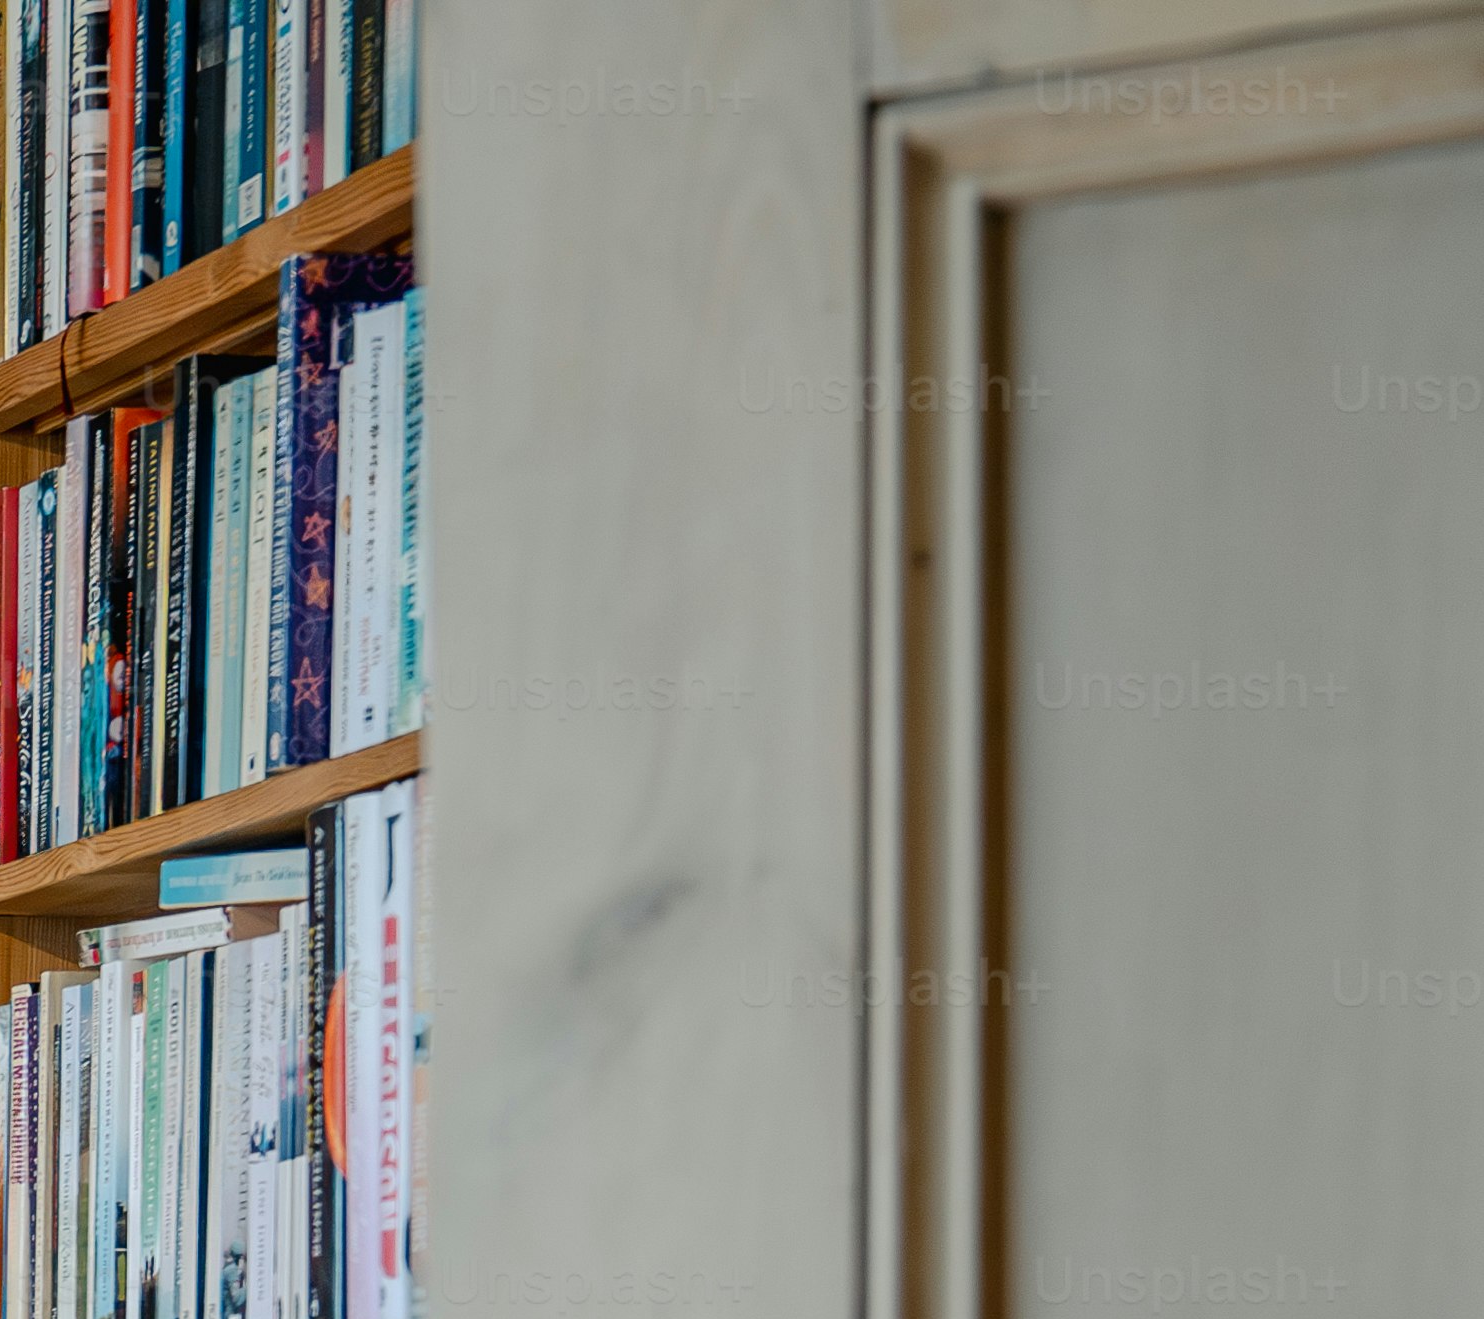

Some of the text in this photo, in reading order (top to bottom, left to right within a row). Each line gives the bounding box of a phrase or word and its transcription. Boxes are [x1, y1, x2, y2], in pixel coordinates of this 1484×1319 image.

[44, 533, 54, 568] Mark
[41, 672, 52, 728] Believe
[13, 996, 27, 1063] BEGGAR
